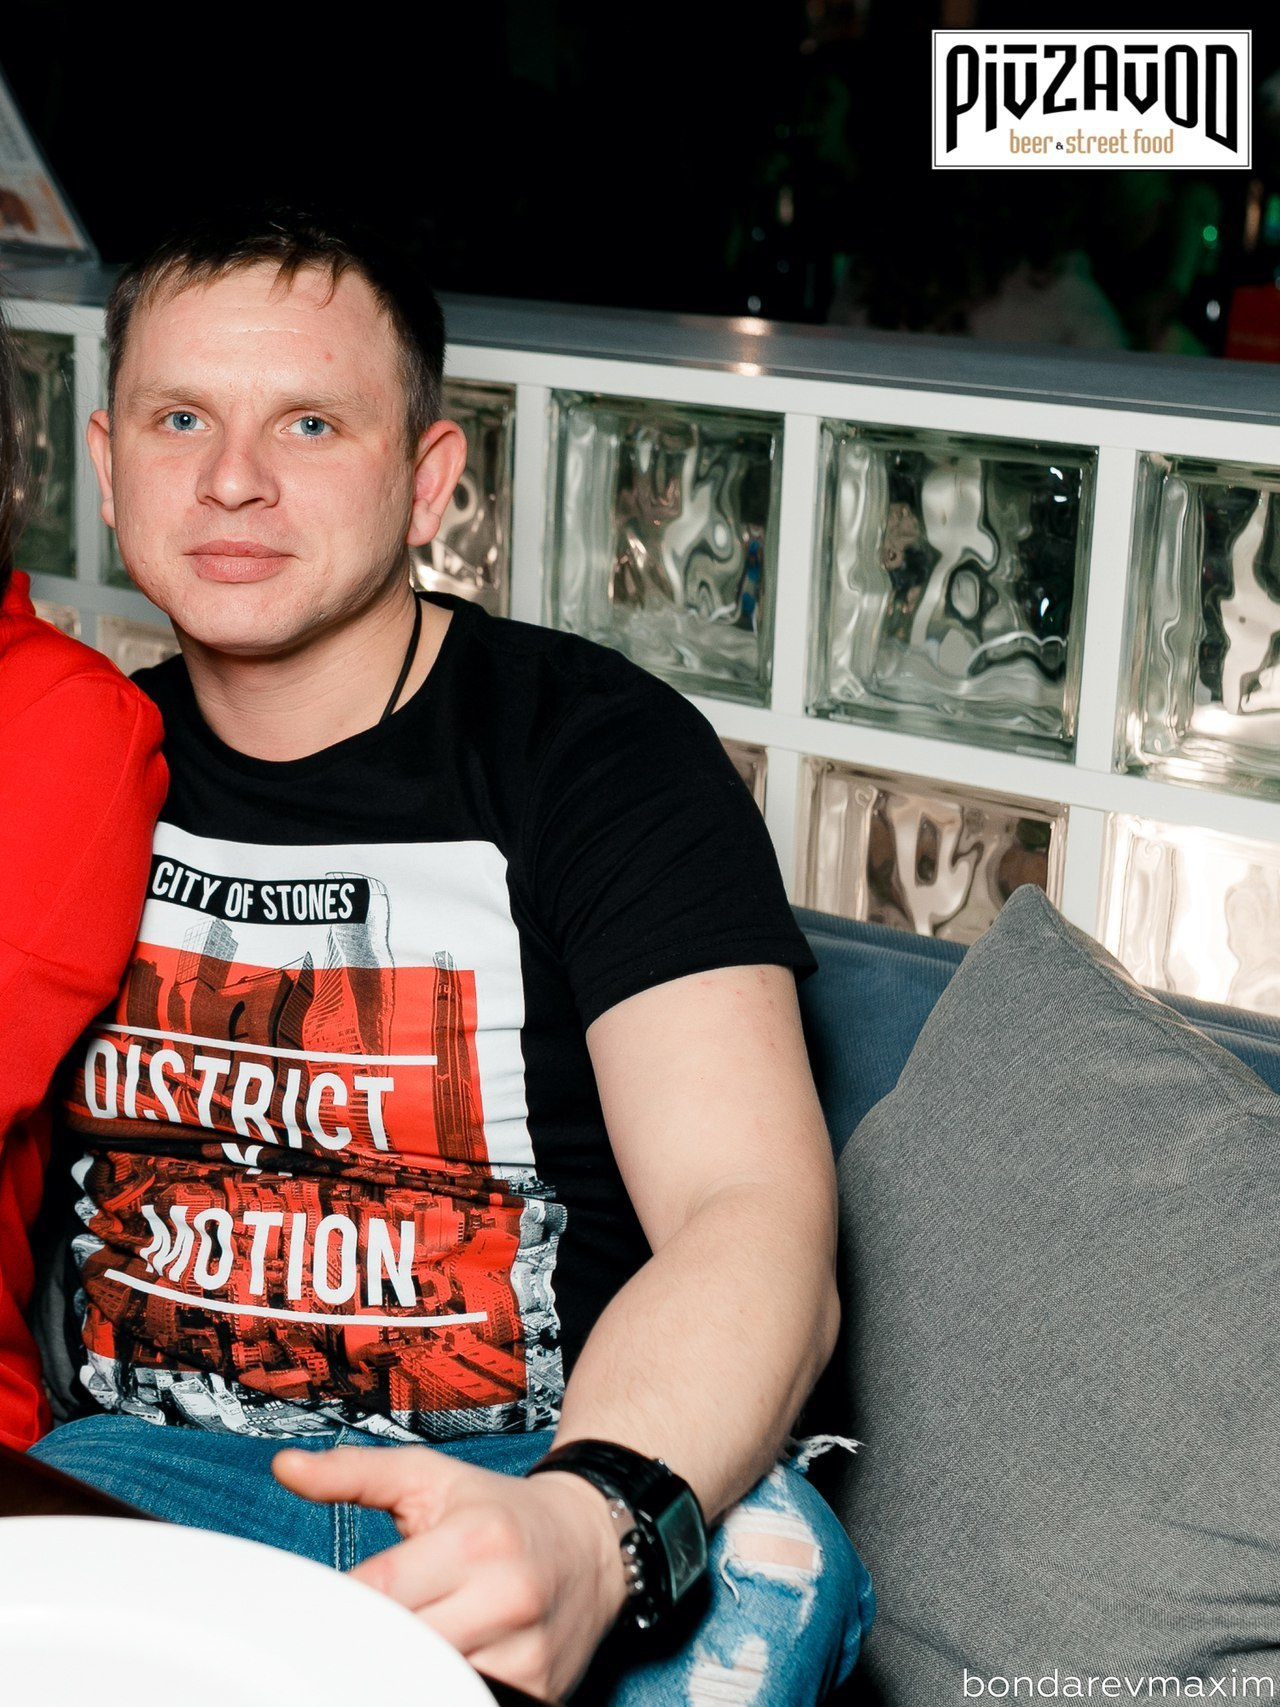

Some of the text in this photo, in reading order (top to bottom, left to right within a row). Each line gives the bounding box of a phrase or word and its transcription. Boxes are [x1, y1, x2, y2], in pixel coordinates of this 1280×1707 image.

[152, 861, 355, 921] CITY OF STONES
[84, 1037, 394, 1152] DISTRICT
[140, 1203, 417, 1308] MOTION
